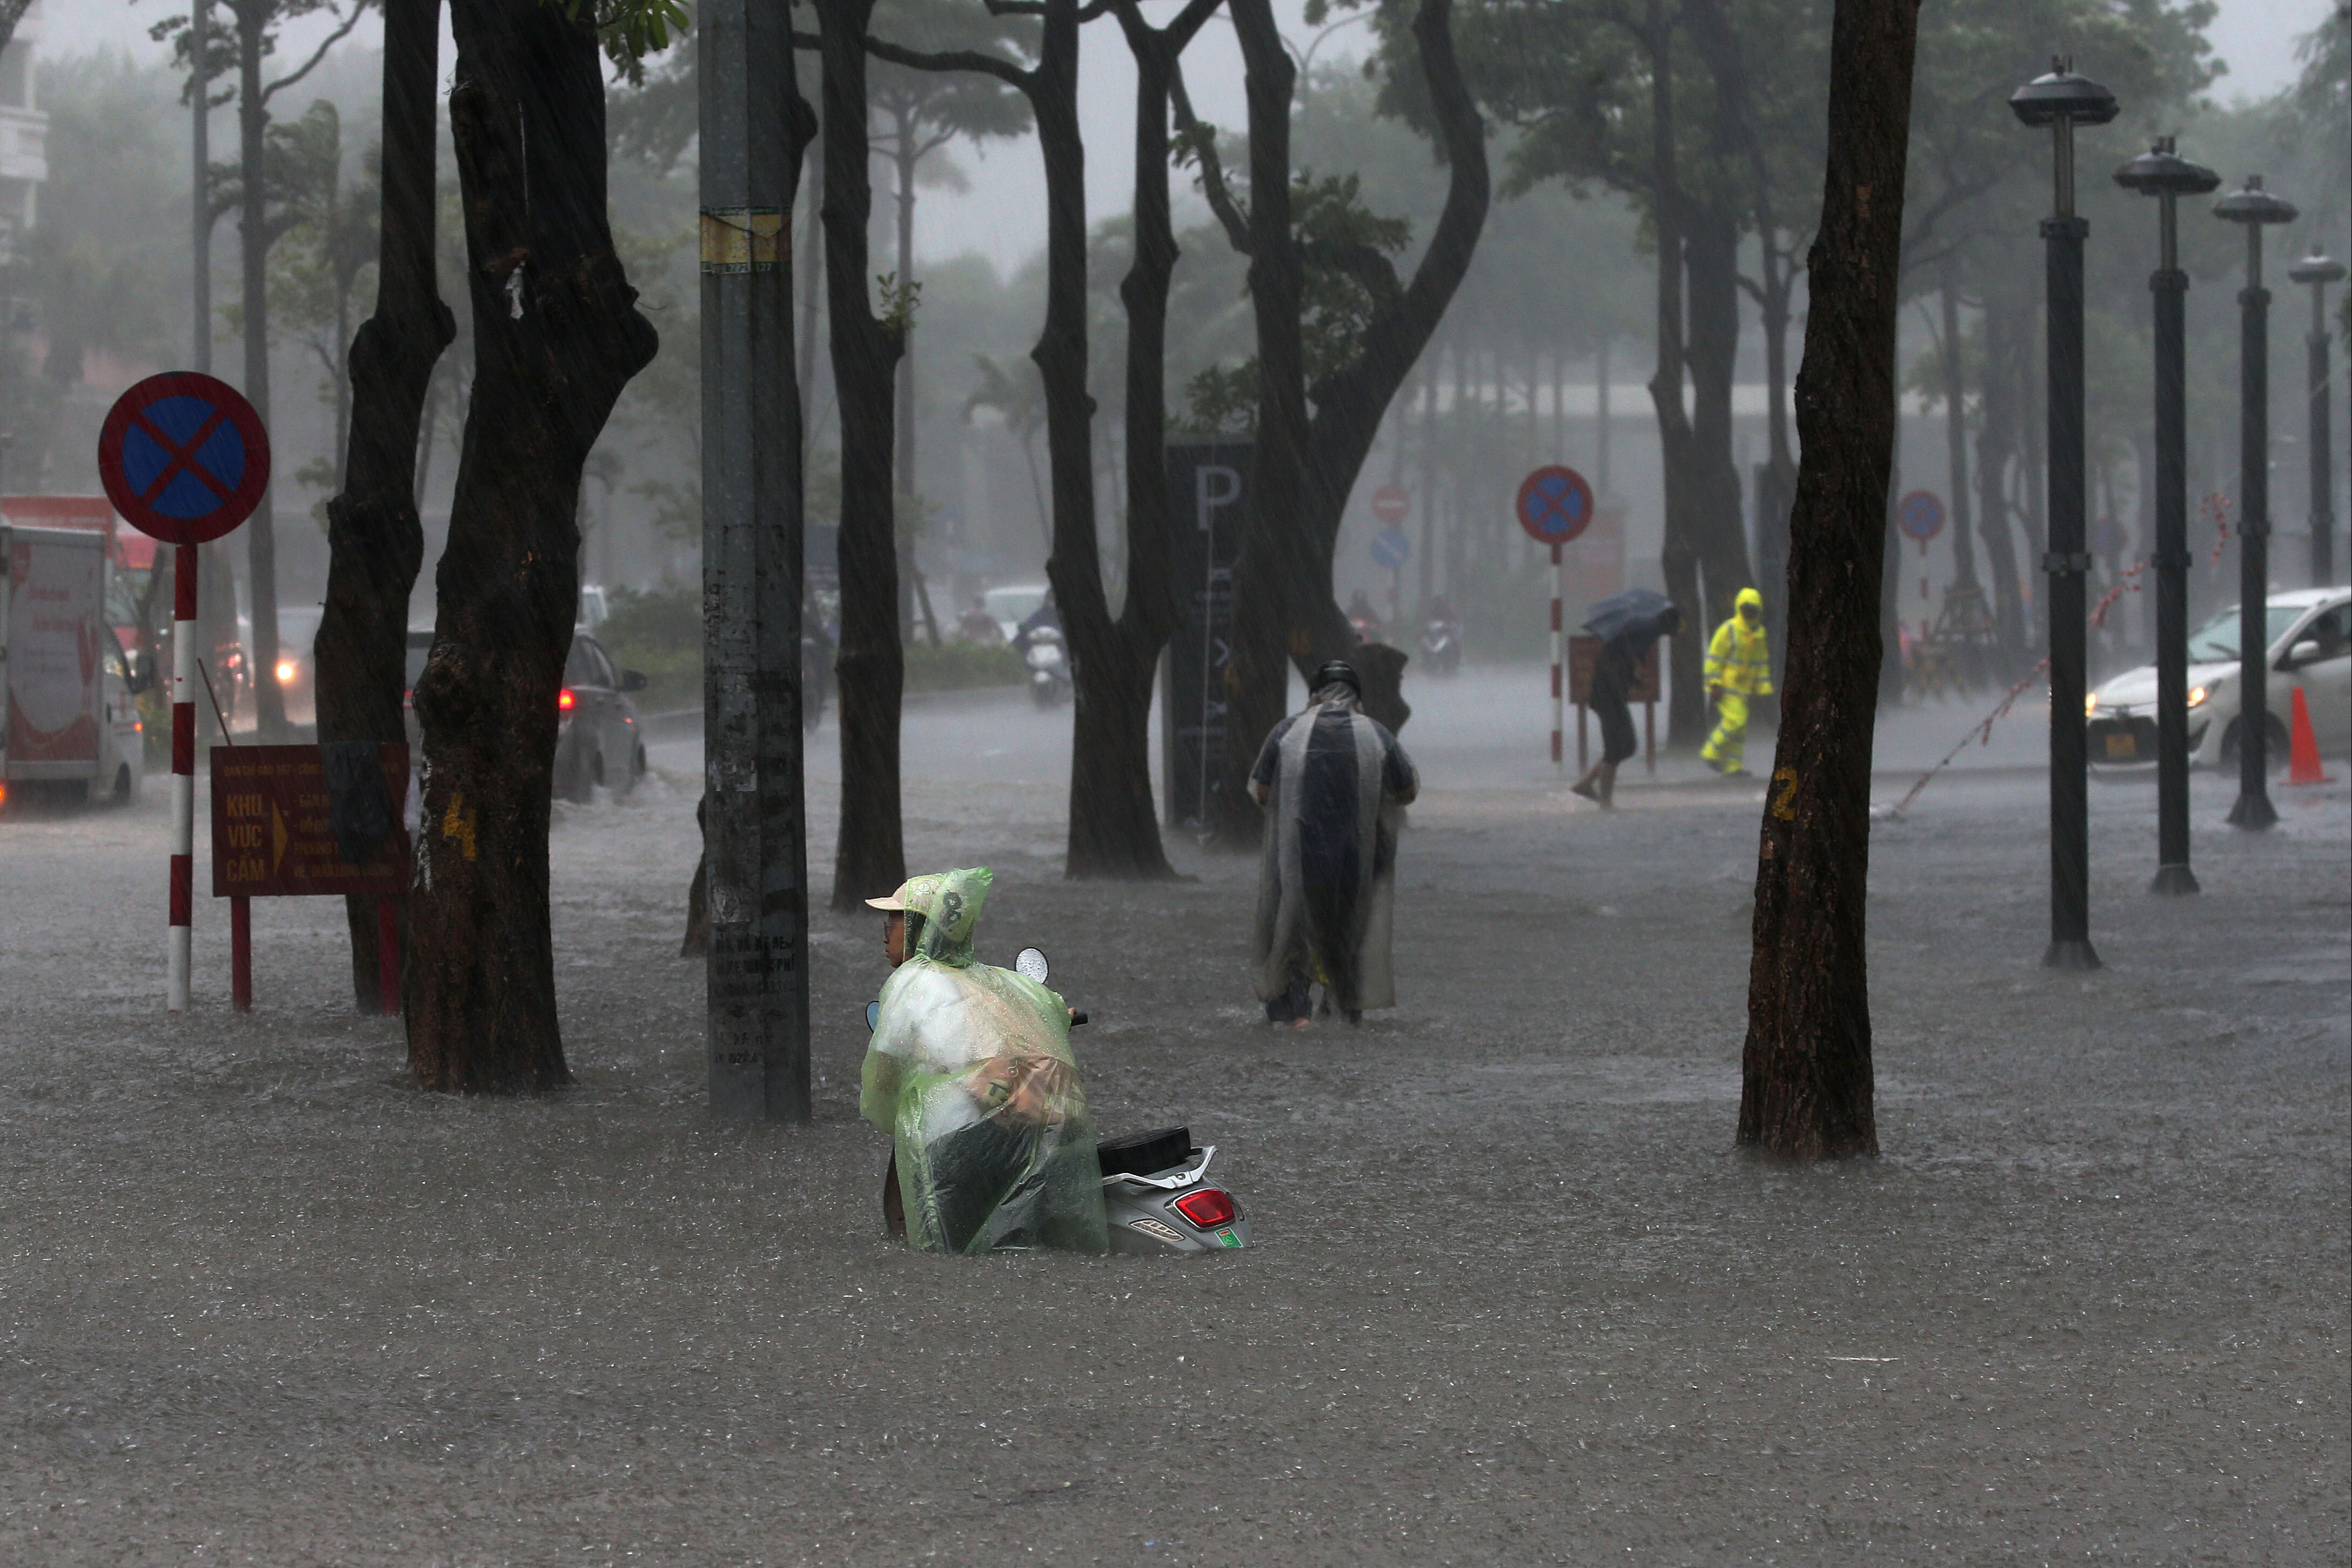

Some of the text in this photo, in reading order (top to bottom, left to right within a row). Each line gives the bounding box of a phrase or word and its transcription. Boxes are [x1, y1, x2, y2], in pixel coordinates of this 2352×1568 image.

[1194, 465, 1242, 532] P
[226, 793, 263, 817] KHU
[1771, 766, 1798, 821] 2
[443, 793, 477, 862] 4
[226, 852, 265, 882] CẤM
